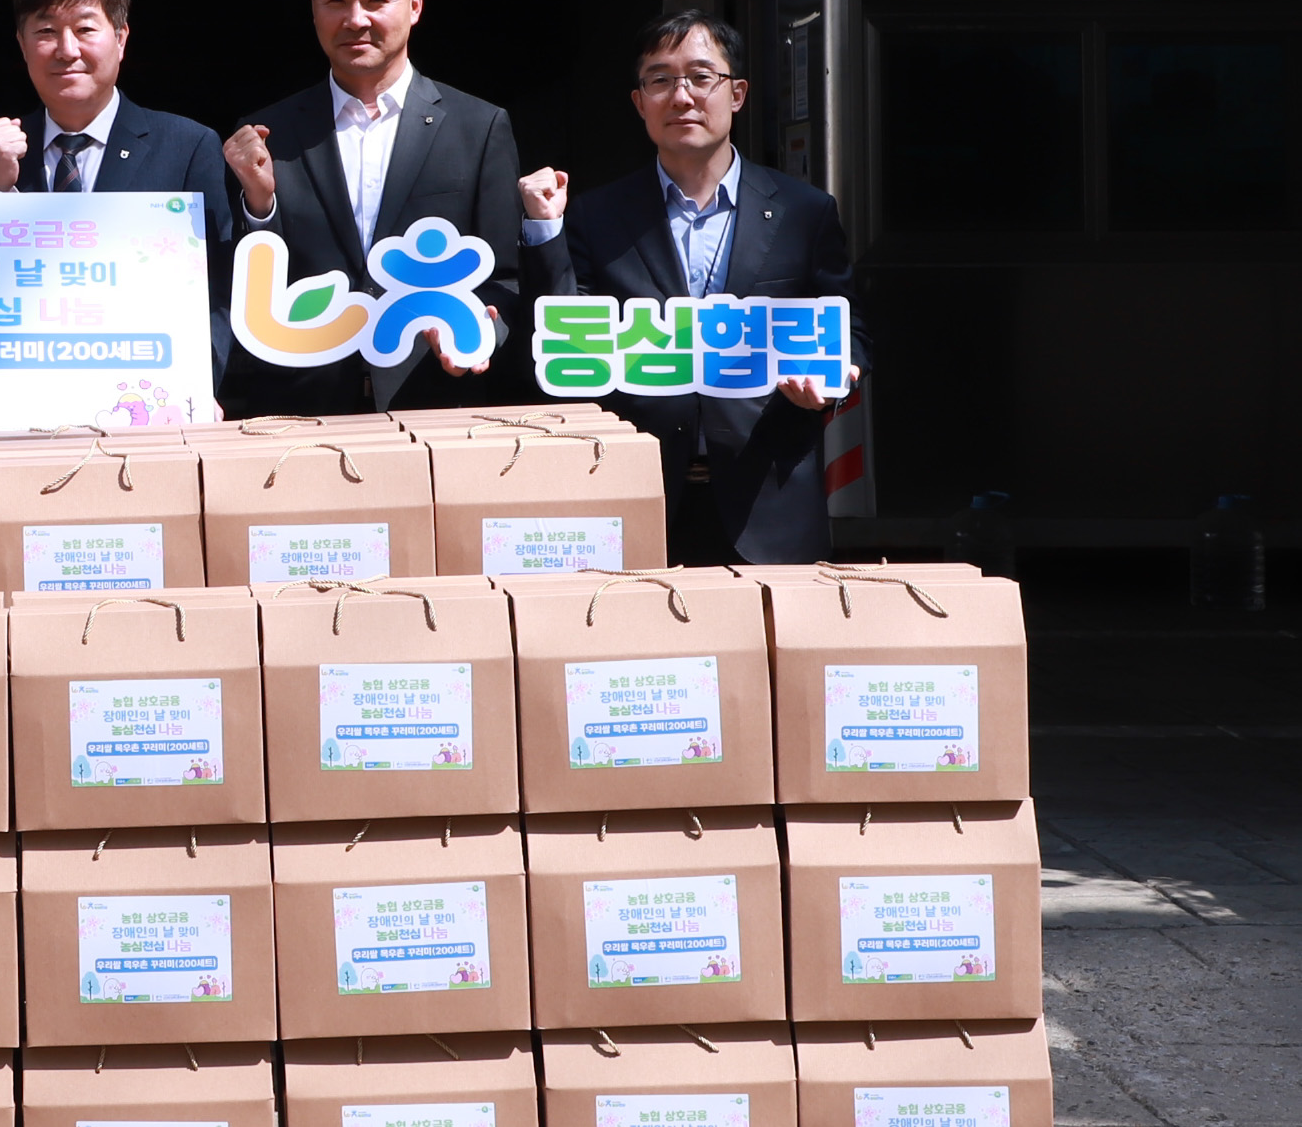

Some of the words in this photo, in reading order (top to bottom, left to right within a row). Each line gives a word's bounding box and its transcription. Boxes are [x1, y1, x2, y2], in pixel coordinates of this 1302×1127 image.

[14, 258, 46, 288] 날
[59, 259, 118, 287] 맞이
[38, 296, 105, 327] 나눔
[542, 303, 842, 389] 동심협력
[63, 539, 81, 549] 농협
[54, 552, 96, 563] 장애인의
[100, 551, 110, 562] 날
[114, 551, 134, 561] 맞이
[62, 564, 102, 575] 농심천심
[104, 564, 127, 575] 나눔
[869, 681, 889, 691] 농협
[112, 695, 132, 706] 농협
[858, 695, 905, 706] 장애인의
[910, 695, 921, 706] 날
[926, 695, 946, 706] 맞이
[103, 709, 148, 721] 장애인의
[153, 708, 164, 720] 날
[169, 708, 189, 720] 맞이
[867, 709, 911, 720] 농심천심
[914, 709, 938, 721] 나눔
[111, 723, 155, 735] 농심천심
[158, 722, 182, 735] 나눔
[842, 728, 867, 737] 우리쌀
[870, 728, 894, 737] 목우촌
[897, 728, 964, 737] 꾸러미(200세트)
[88, 743, 112, 752] 우리쌀
[114, 742, 139, 751] 목우촌
[142, 741, 207, 751] 꾸러미(200세트)
[627, 894, 647, 906] 농협
[618, 907, 664, 921] 장애인의
[669, 906, 680, 919] 날
[685, 906, 705, 918] 맞이
[626, 921, 671, 934] 농심천심
[673, 920, 698, 933] 나눔
[603, 942, 628, 953] 우리쌀
[630, 941, 655, 951] 목우촌
[658, 938, 725, 950] 꾸러미(200세트)
[897, 1103, 919, 1115] 농협
[639, 1111, 660, 1122] 농협
